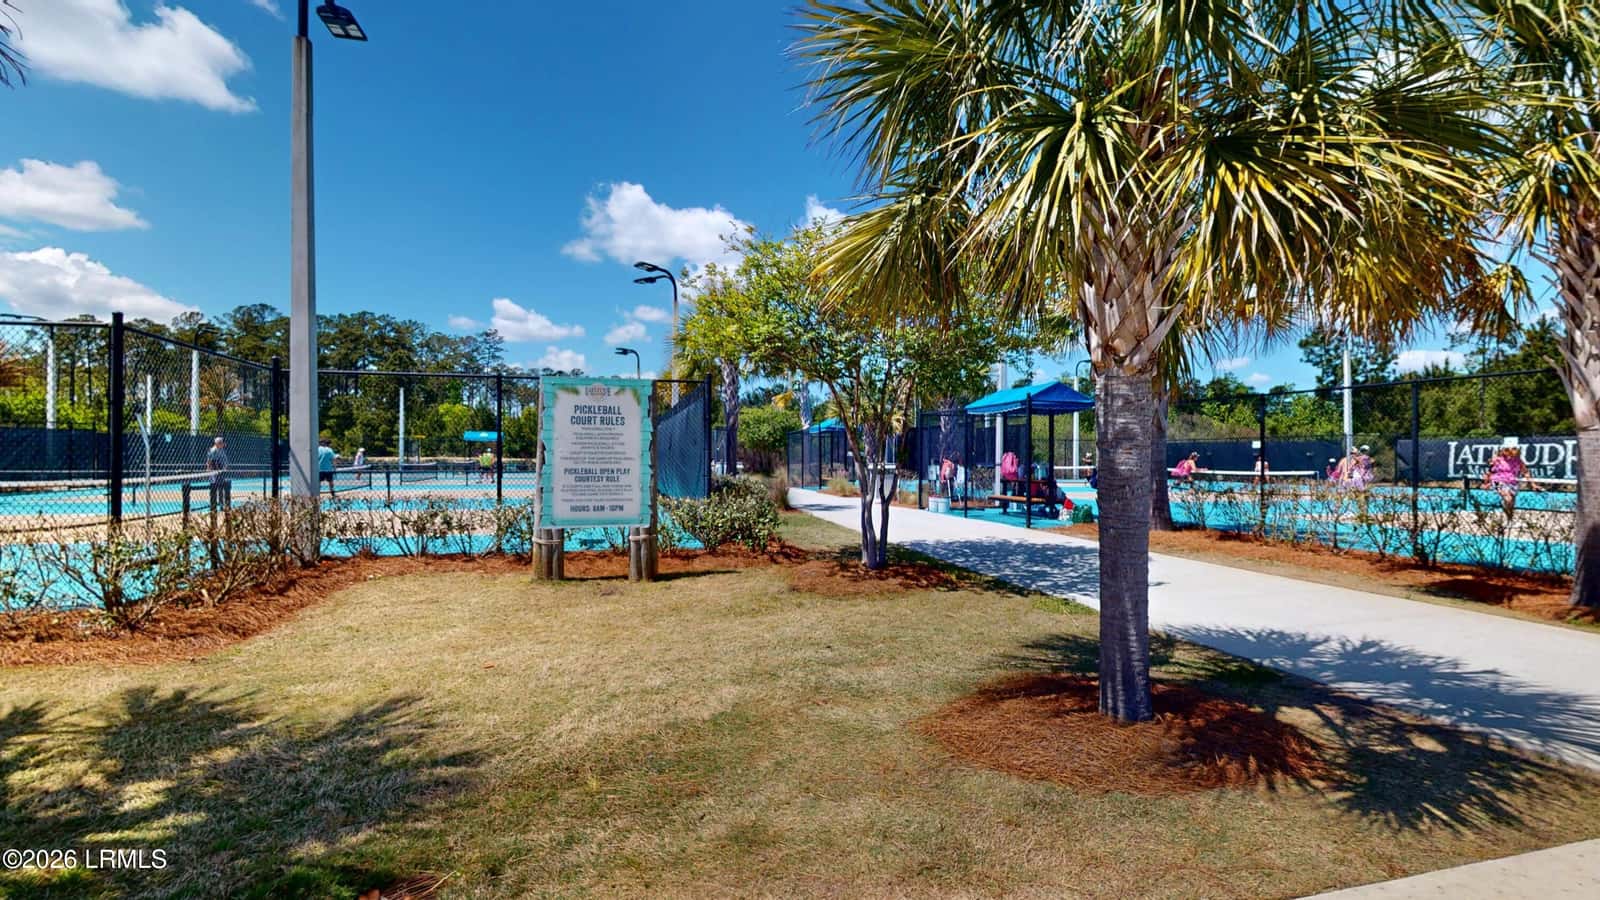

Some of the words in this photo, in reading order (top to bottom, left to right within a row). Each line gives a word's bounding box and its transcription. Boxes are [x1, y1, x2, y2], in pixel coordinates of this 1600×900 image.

[574, 404, 622, 415] PICKLEBALL
[570, 416, 597, 425] COURT
[599, 416, 626, 426] RULES
[563, 467, 598, 475] PICKLEBALL
[574, 475, 604, 483] COURTESY
[605, 475, 620, 483] RULE
